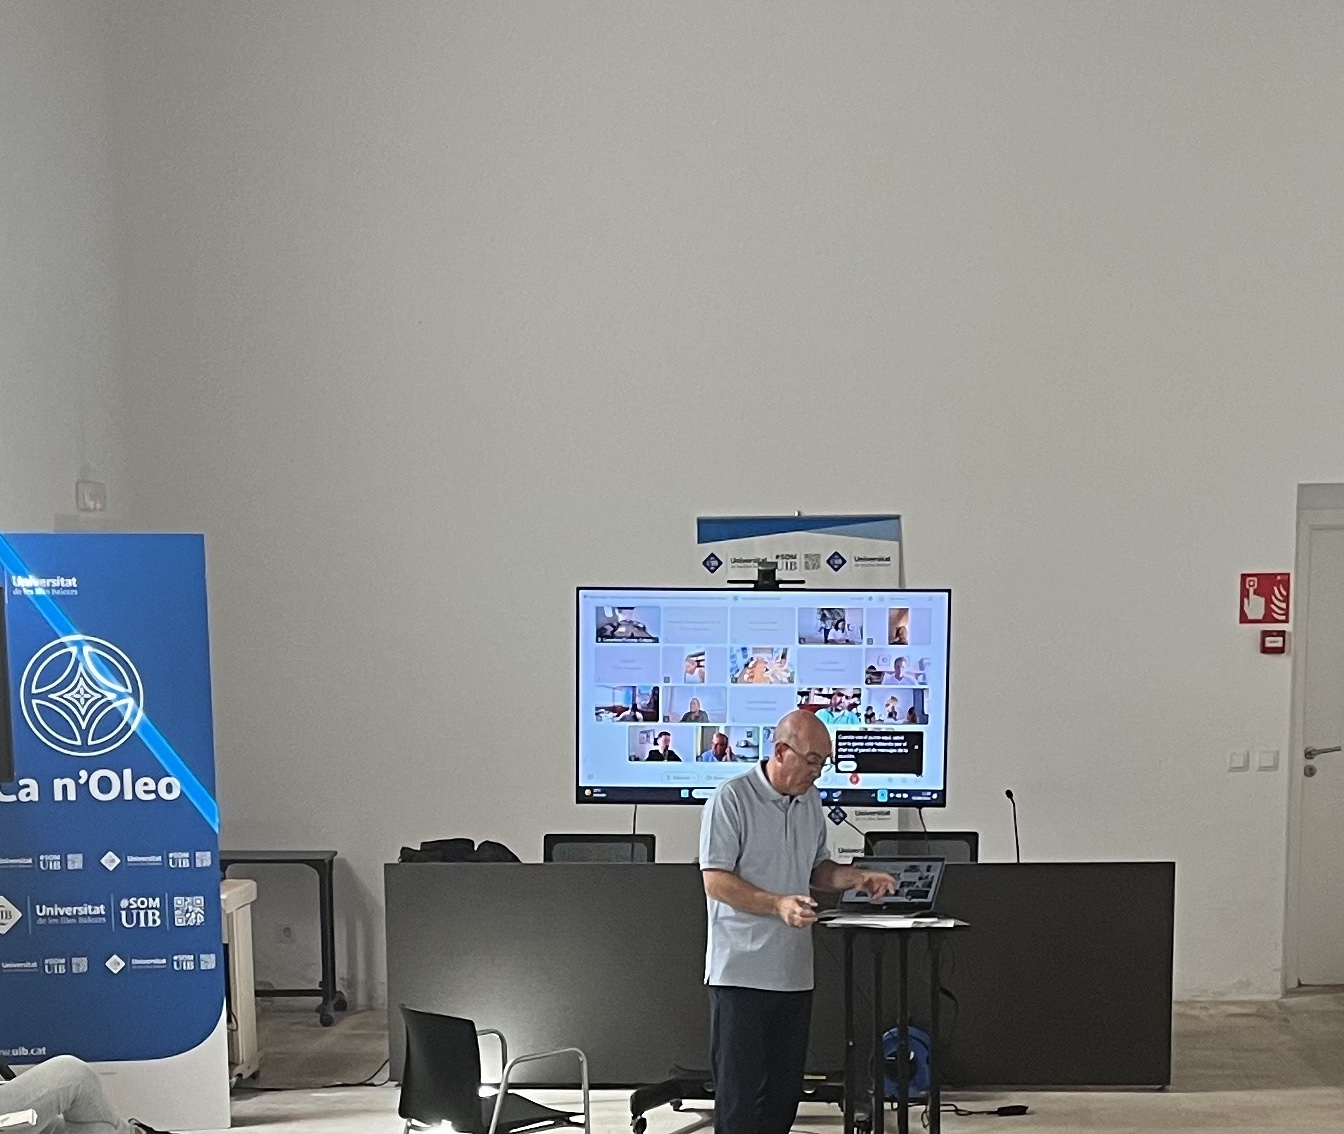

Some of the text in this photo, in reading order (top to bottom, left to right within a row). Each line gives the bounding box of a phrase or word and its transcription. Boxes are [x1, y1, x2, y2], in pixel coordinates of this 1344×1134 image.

[11, 575, 78, 588] Universitat
[53, 768, 182, 802] n’Oleo
[39, 860, 61, 871] UIB
[168, 858, 190, 869] UIB
[119, 897, 161, 909] #SOM
[35, 903, 106, 917] Universitat
[119, 909, 162, 928] UIB
[44, 963, 66, 975] UIB
